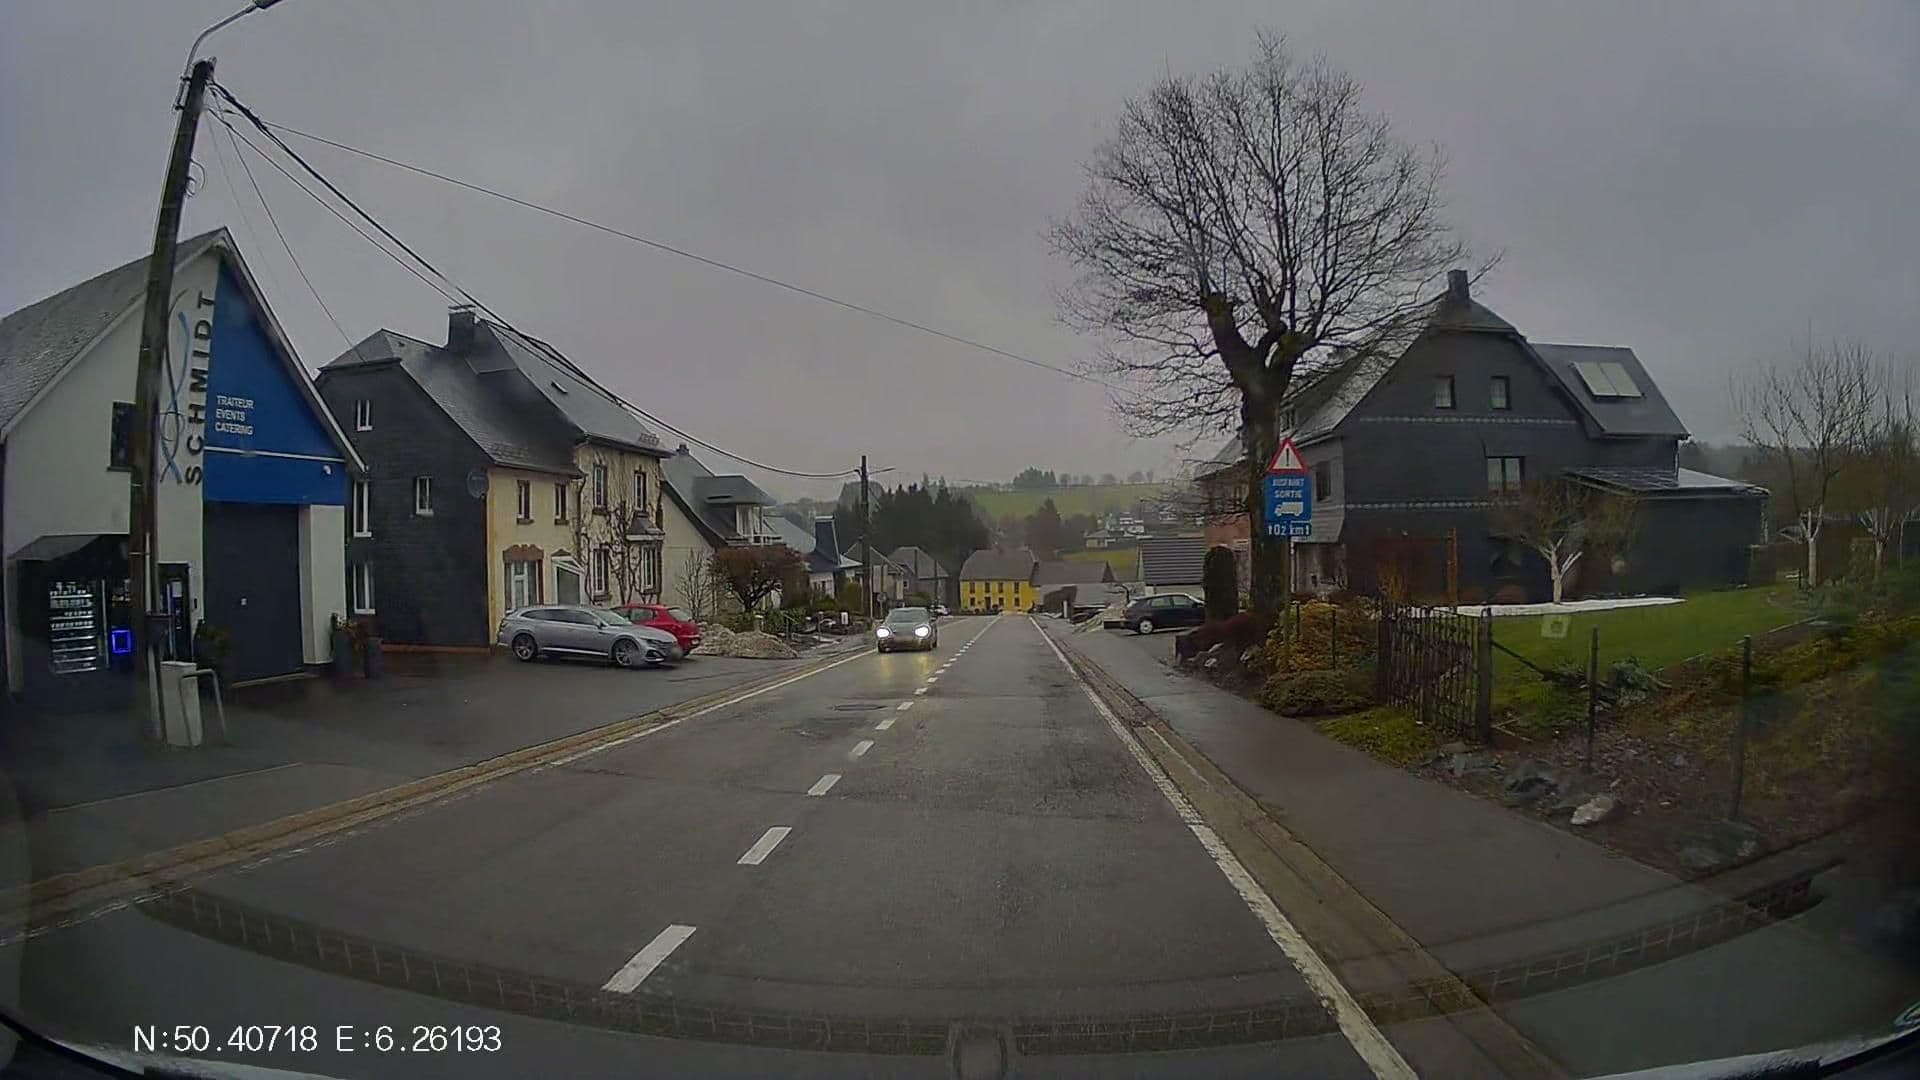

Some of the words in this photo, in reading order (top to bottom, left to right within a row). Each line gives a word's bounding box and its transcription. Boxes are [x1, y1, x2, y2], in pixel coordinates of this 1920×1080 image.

[185, 292, 215, 486] SCHMIDT
[216, 395, 254, 409] TRAITEUR
[216, 408, 246, 422] EVENTS
[215, 421, 254, 435] CATERING
